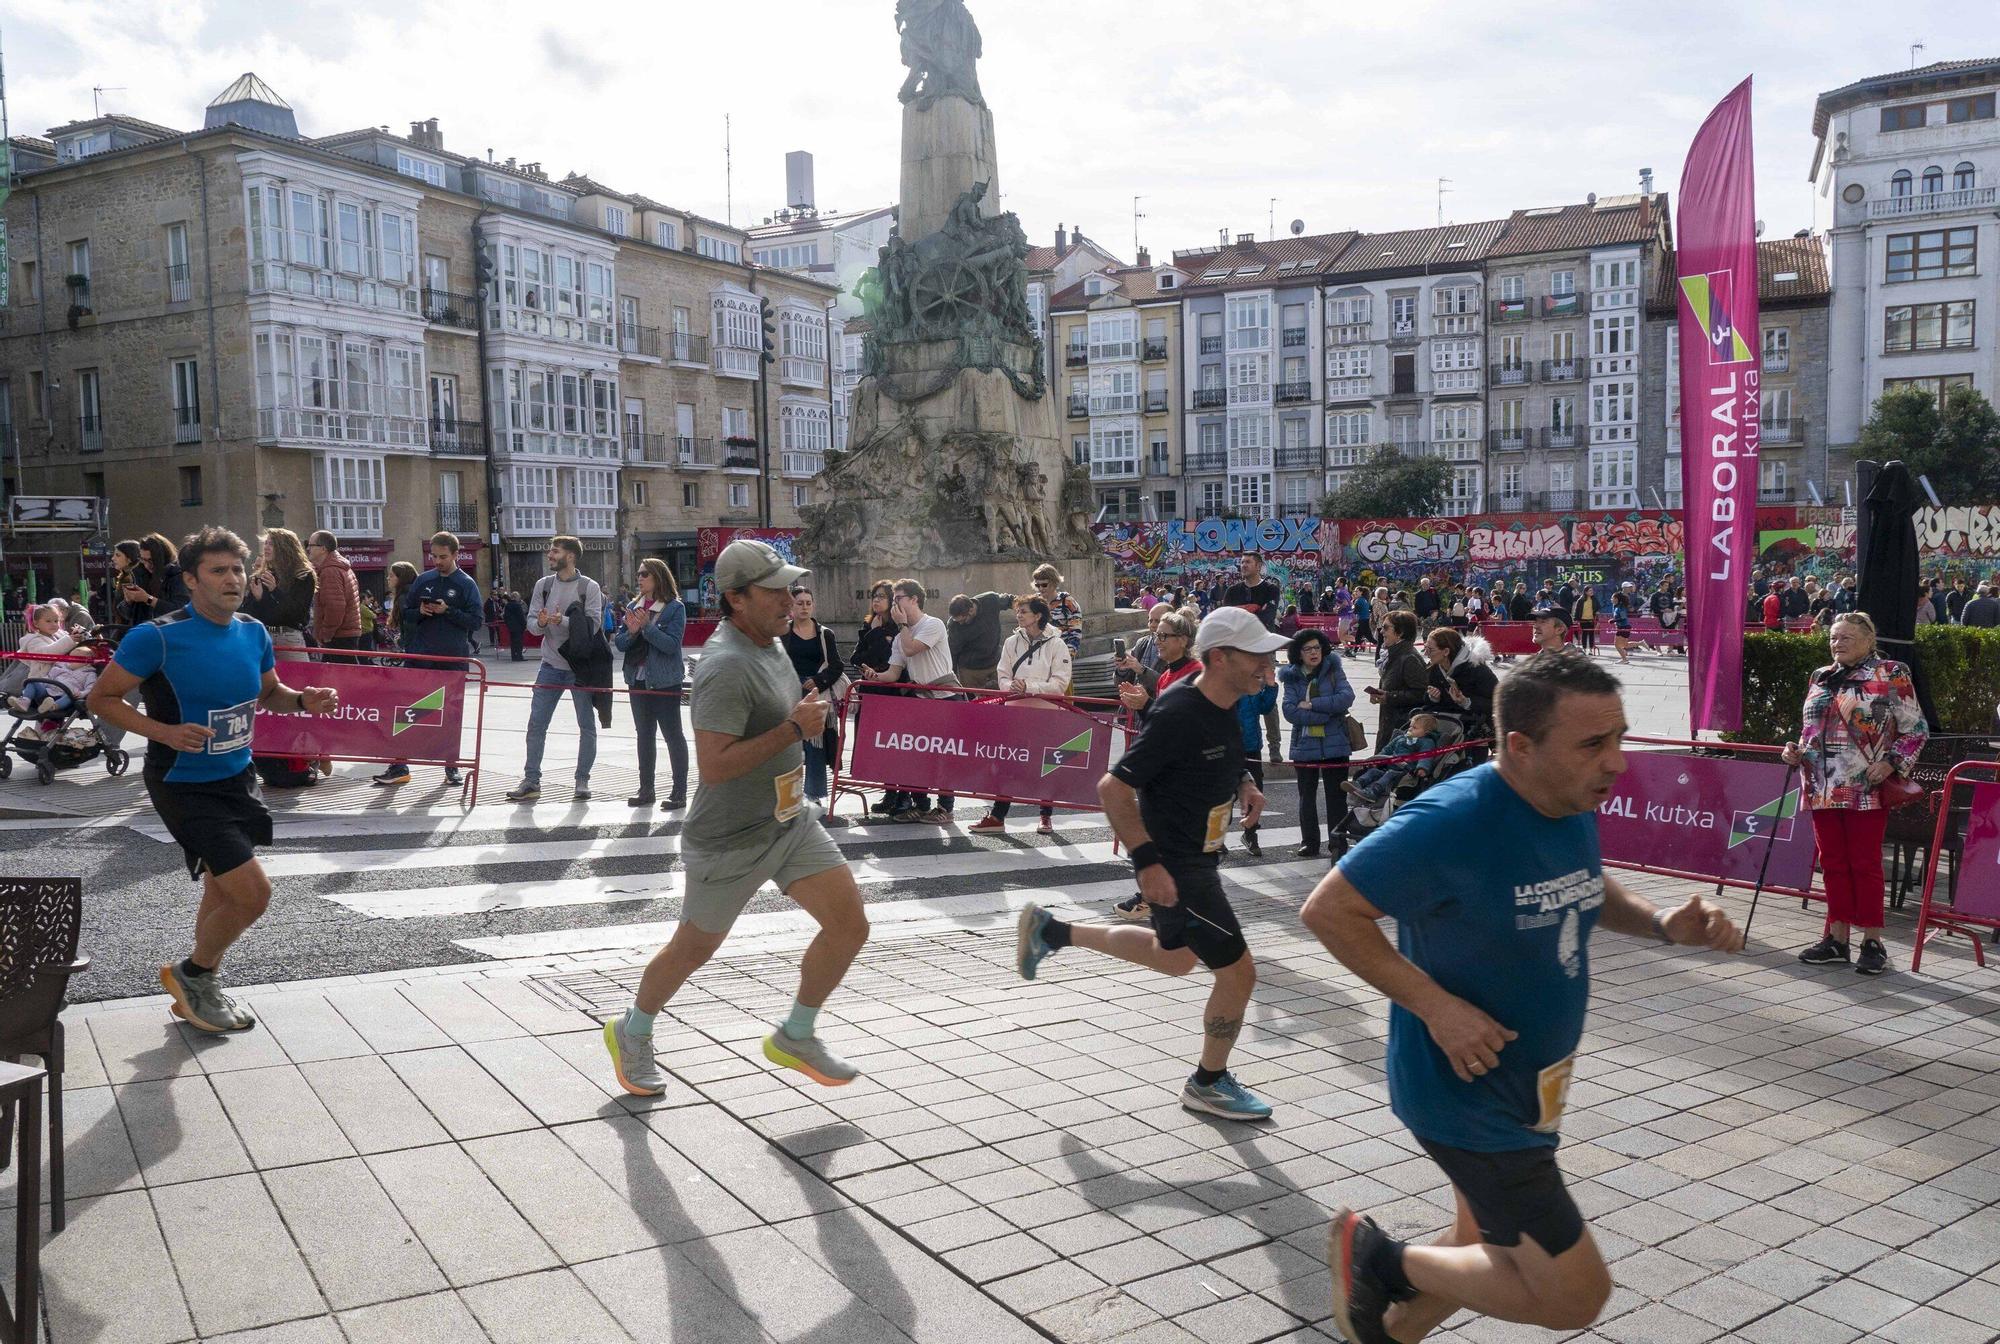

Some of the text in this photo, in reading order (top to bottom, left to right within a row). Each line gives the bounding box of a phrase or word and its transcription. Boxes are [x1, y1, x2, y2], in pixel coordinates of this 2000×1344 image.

[1742, 369, 1758, 457] kutxa
[1710, 371, 1738, 581] LABORAL
[456, 552, 473, 562] ptika
[512, 542, 552, 552] TEJIDO
[874, 731, 1030, 762] LABORAL kutxa
[1644, 800, 1715, 829] kutxa
